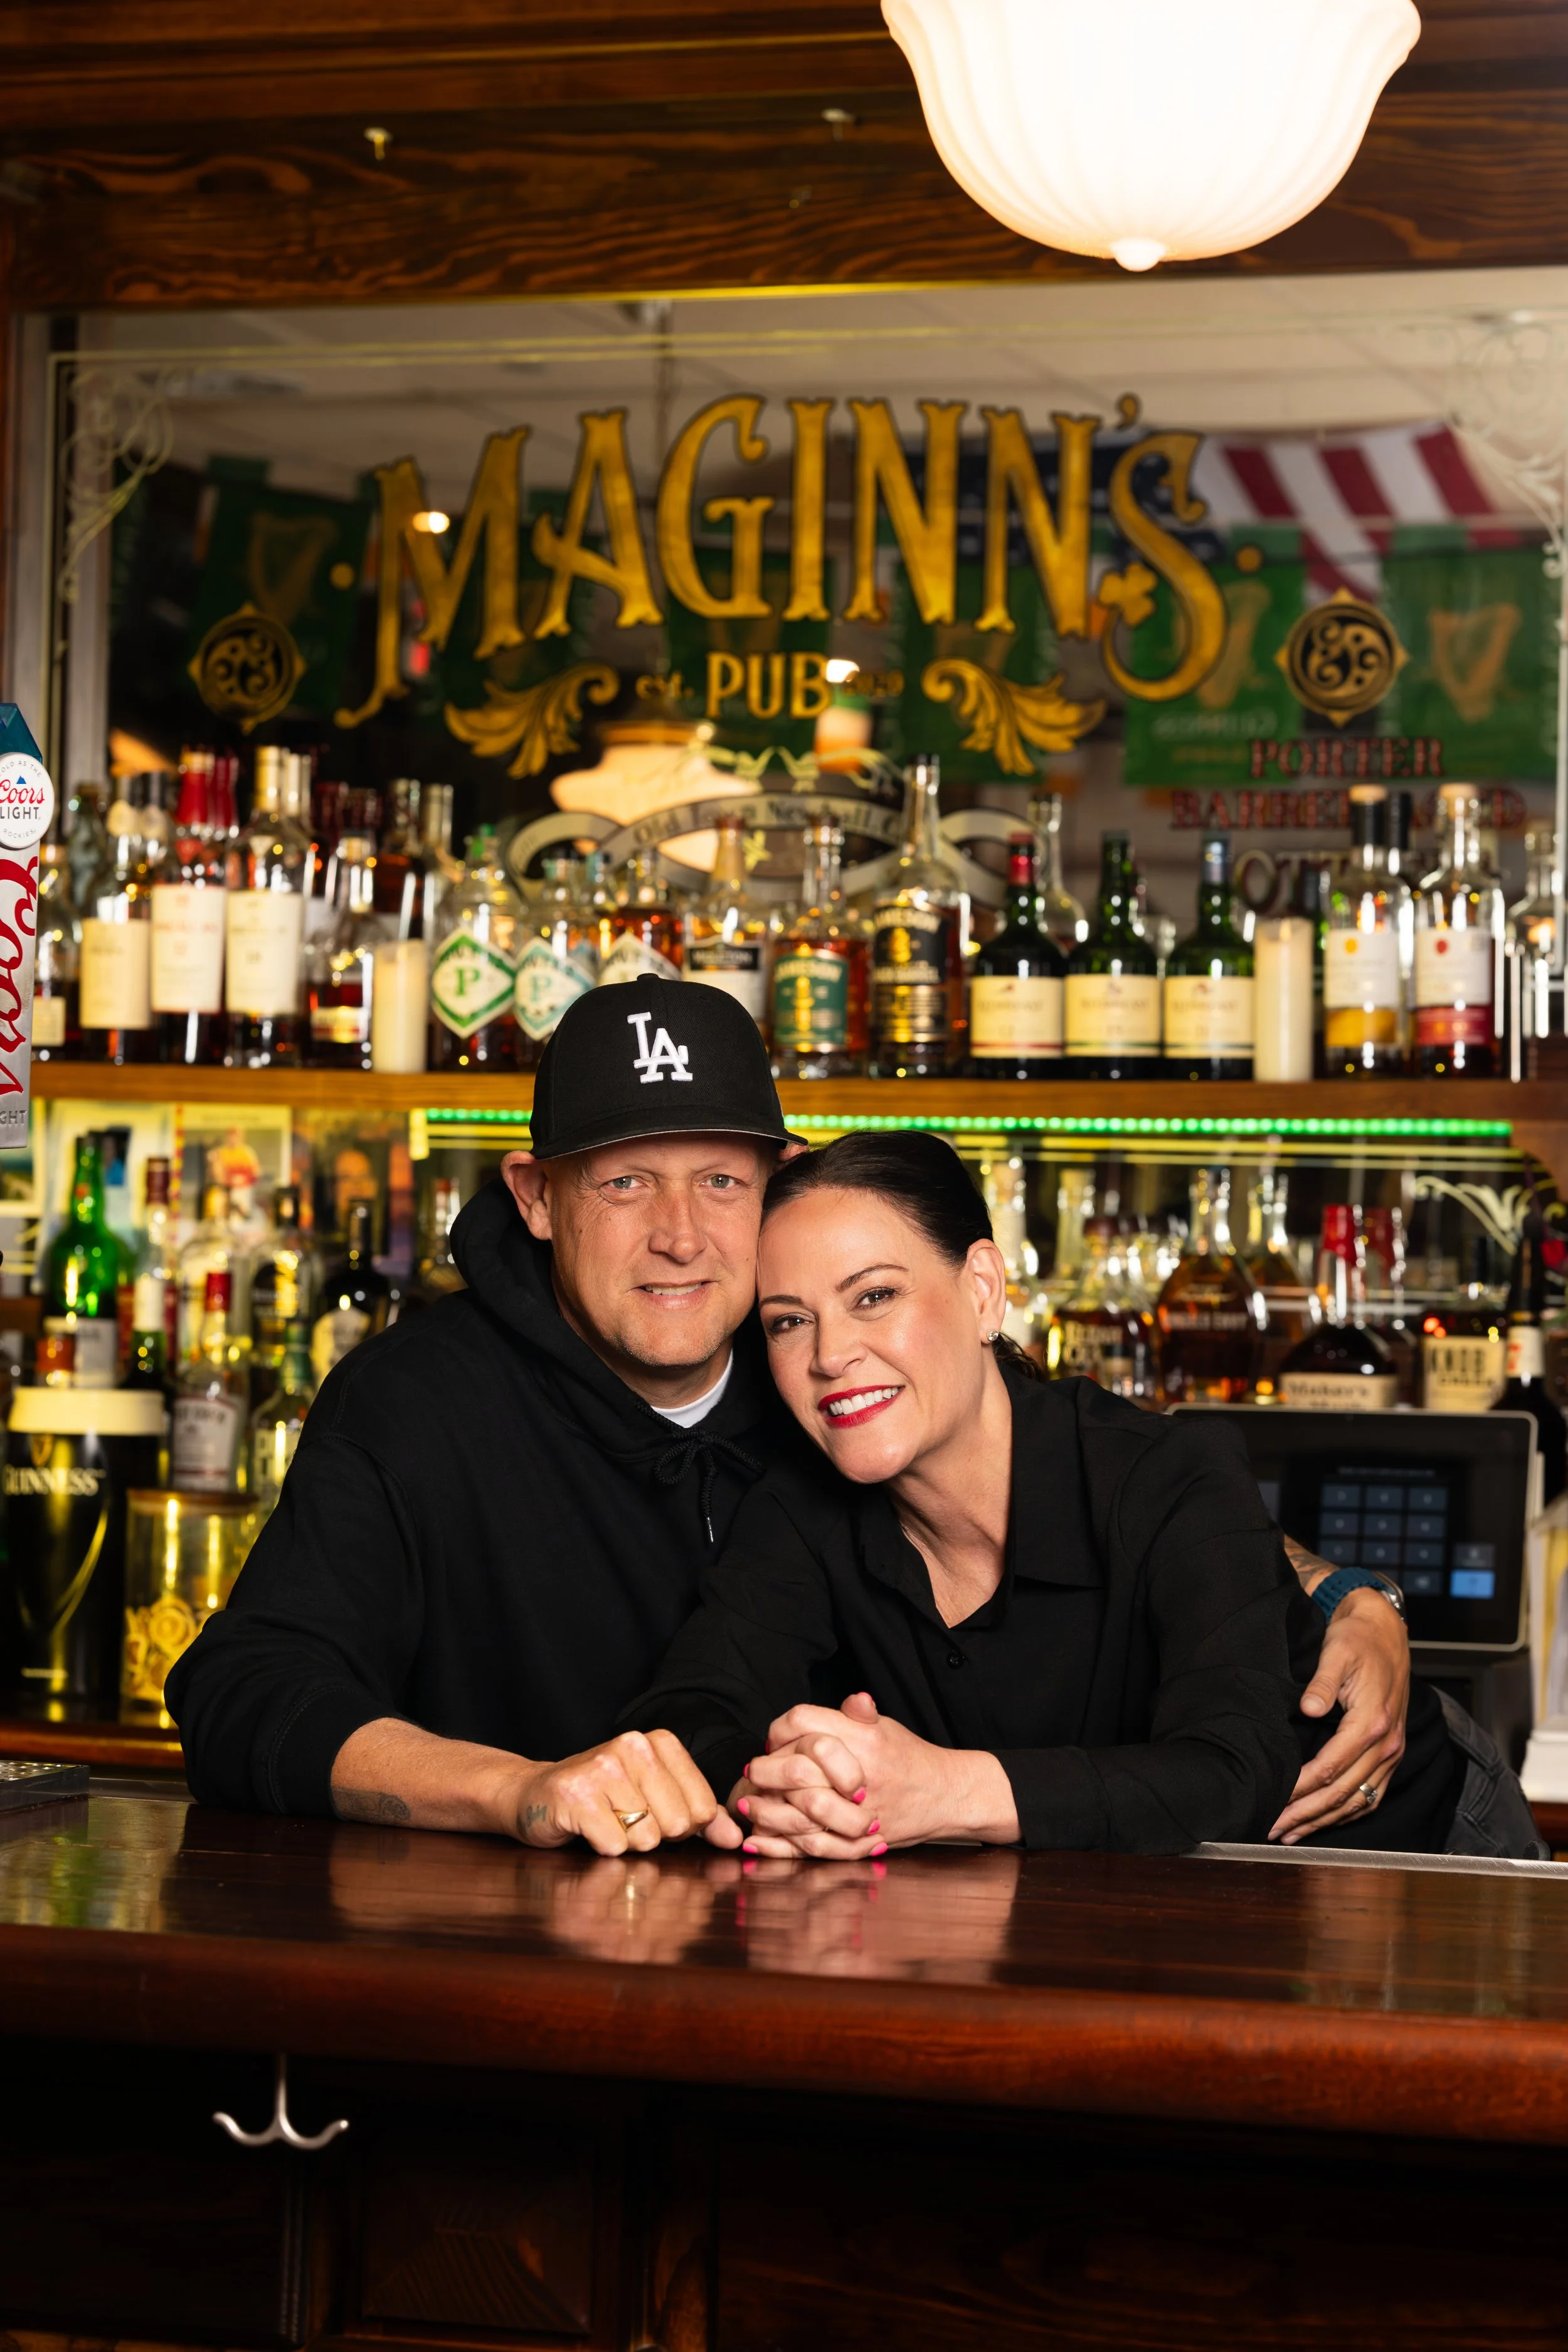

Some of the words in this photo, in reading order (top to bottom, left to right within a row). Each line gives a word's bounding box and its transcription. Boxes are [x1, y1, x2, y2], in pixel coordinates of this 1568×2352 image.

[334, 393, 1227, 728] MAGINN'S
[705, 650, 834, 720] PUB
[0, 761, 14, 774] OLD
[30, 764, 41, 778] THE
[1249, 737, 1443, 778] PORTER
[0, 780, 45, 804] Coors
[0, 807, 39, 820] LIGHT
[456, 967, 480, 997] P
[531, 975, 551, 1004] P
[627, 1012, 693, 1084] LA
[0, 1110, 26, 1126] GHT
